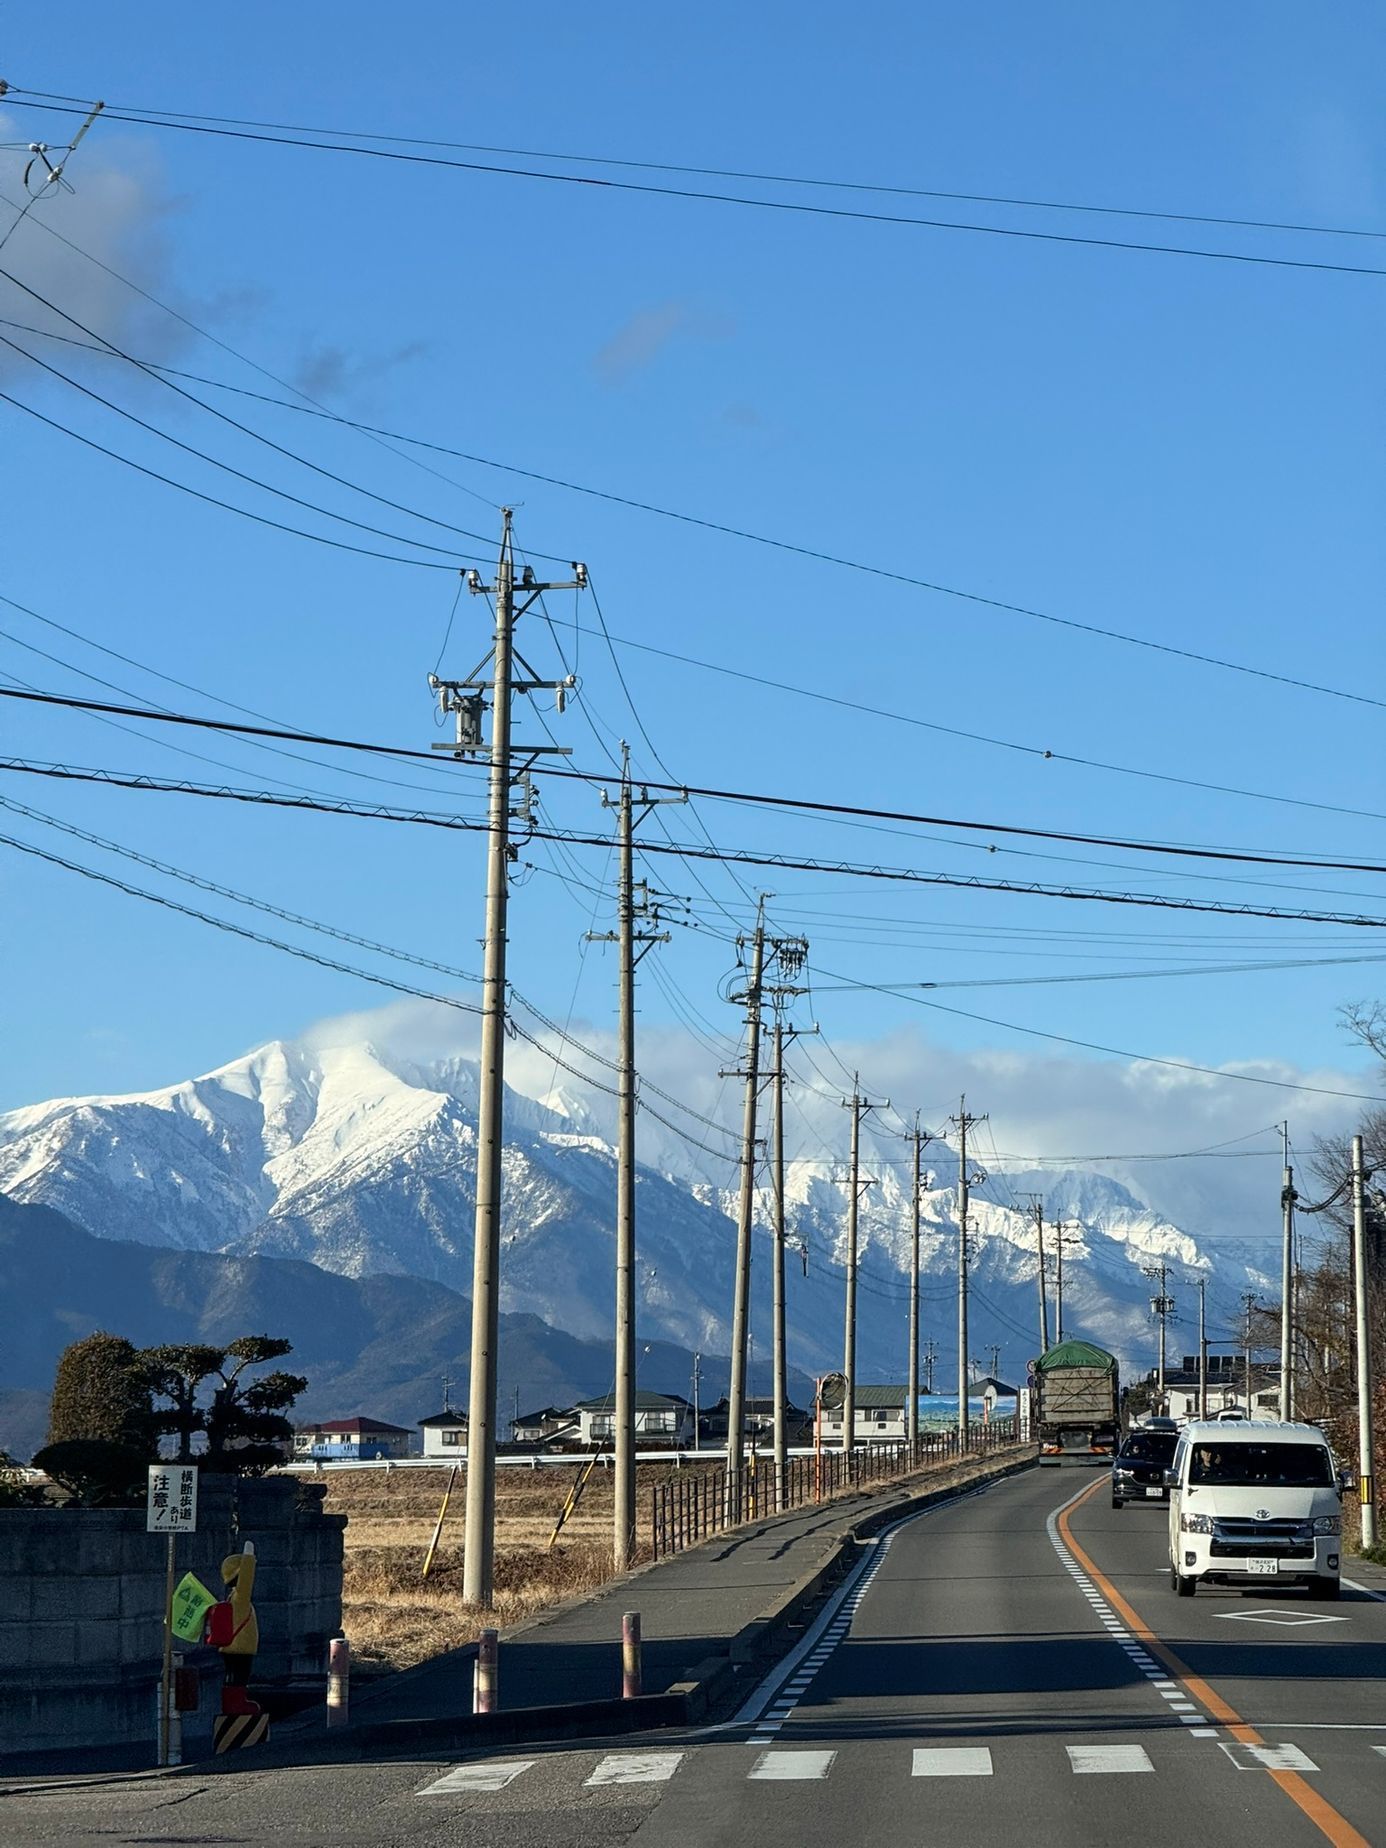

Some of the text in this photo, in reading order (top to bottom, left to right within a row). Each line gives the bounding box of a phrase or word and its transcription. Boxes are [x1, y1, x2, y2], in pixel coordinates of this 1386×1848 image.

[153, 1475, 170, 1521] 注意！
[170, 1506, 179, 1524] あり
[180, 1470, 193, 1520] 横断歩道
